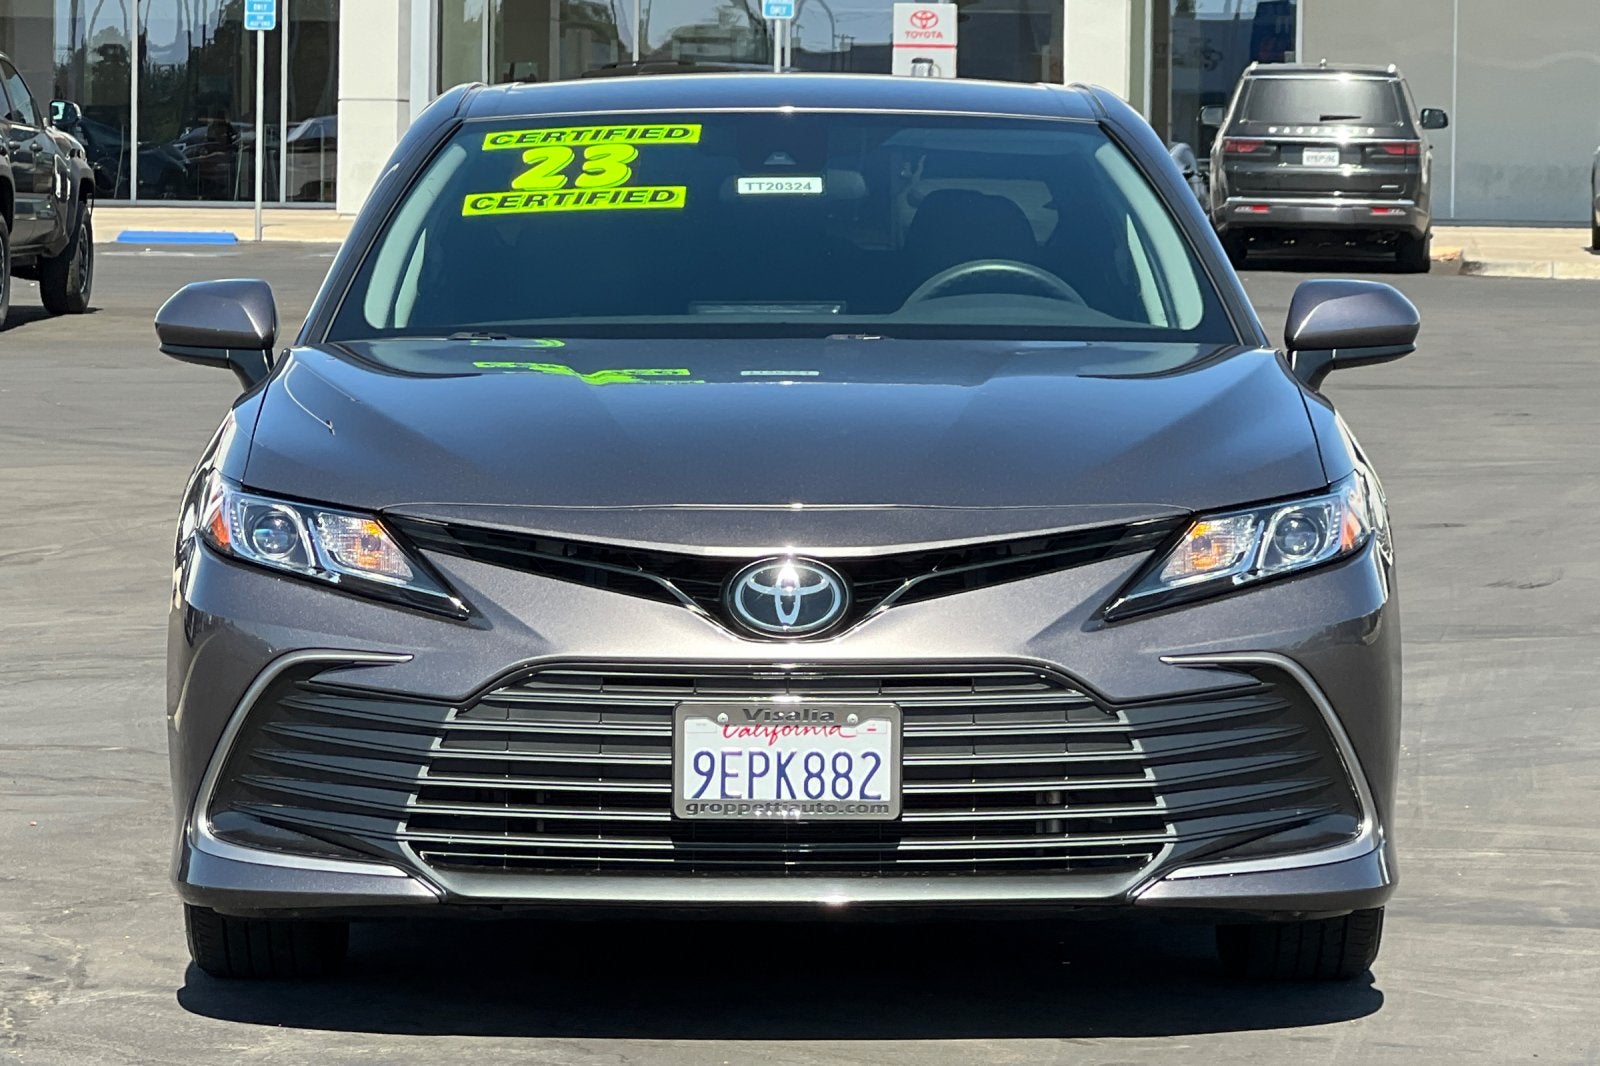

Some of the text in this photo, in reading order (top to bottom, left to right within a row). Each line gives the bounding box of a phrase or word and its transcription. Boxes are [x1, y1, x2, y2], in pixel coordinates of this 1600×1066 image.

[905, 31, 943, 40] TOYOTA
[489, 127, 693, 147] CERTIFIED
[510, 144, 639, 190] 23
[744, 181, 813, 192] TT20324
[470, 190, 676, 211] CERTIFIED
[742, 708, 835, 723] Visalia
[692, 750, 882, 800] 9EPK882
[685, 802, 889, 816] groppettiauto.com
